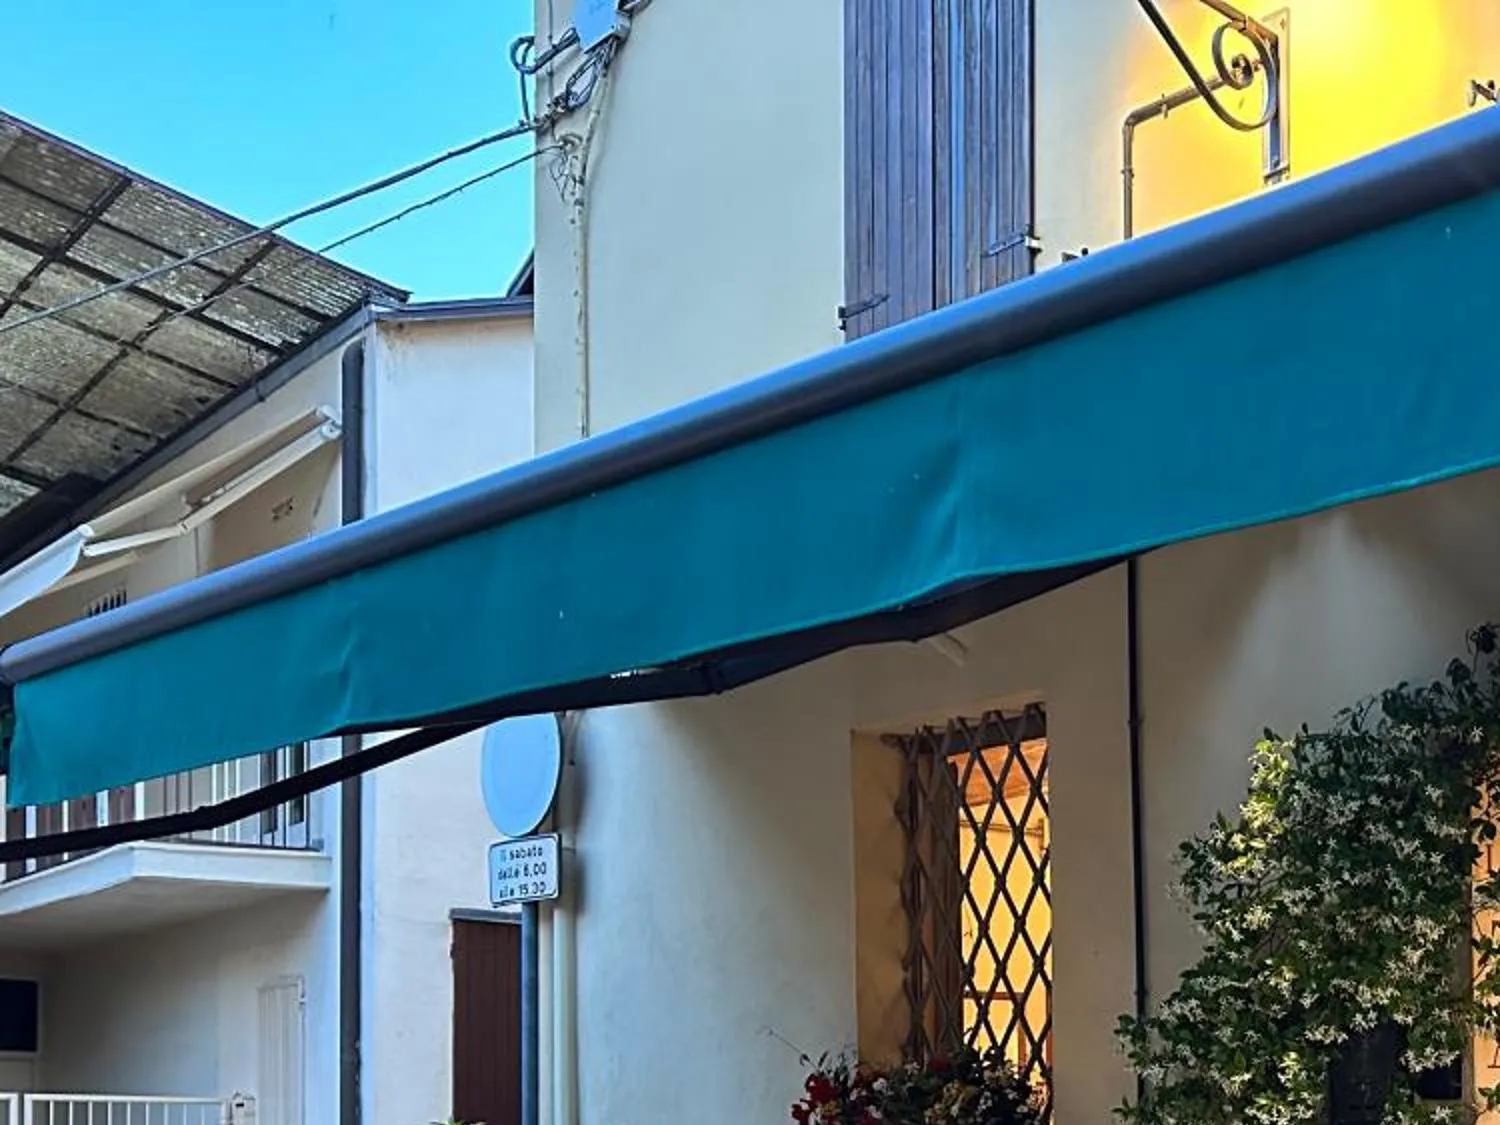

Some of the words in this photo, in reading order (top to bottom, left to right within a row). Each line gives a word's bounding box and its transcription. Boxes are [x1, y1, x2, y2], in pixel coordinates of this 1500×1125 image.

[509, 844, 543, 860] sabato
[498, 866, 519, 880] dalle
[499, 884, 514, 898] alle
